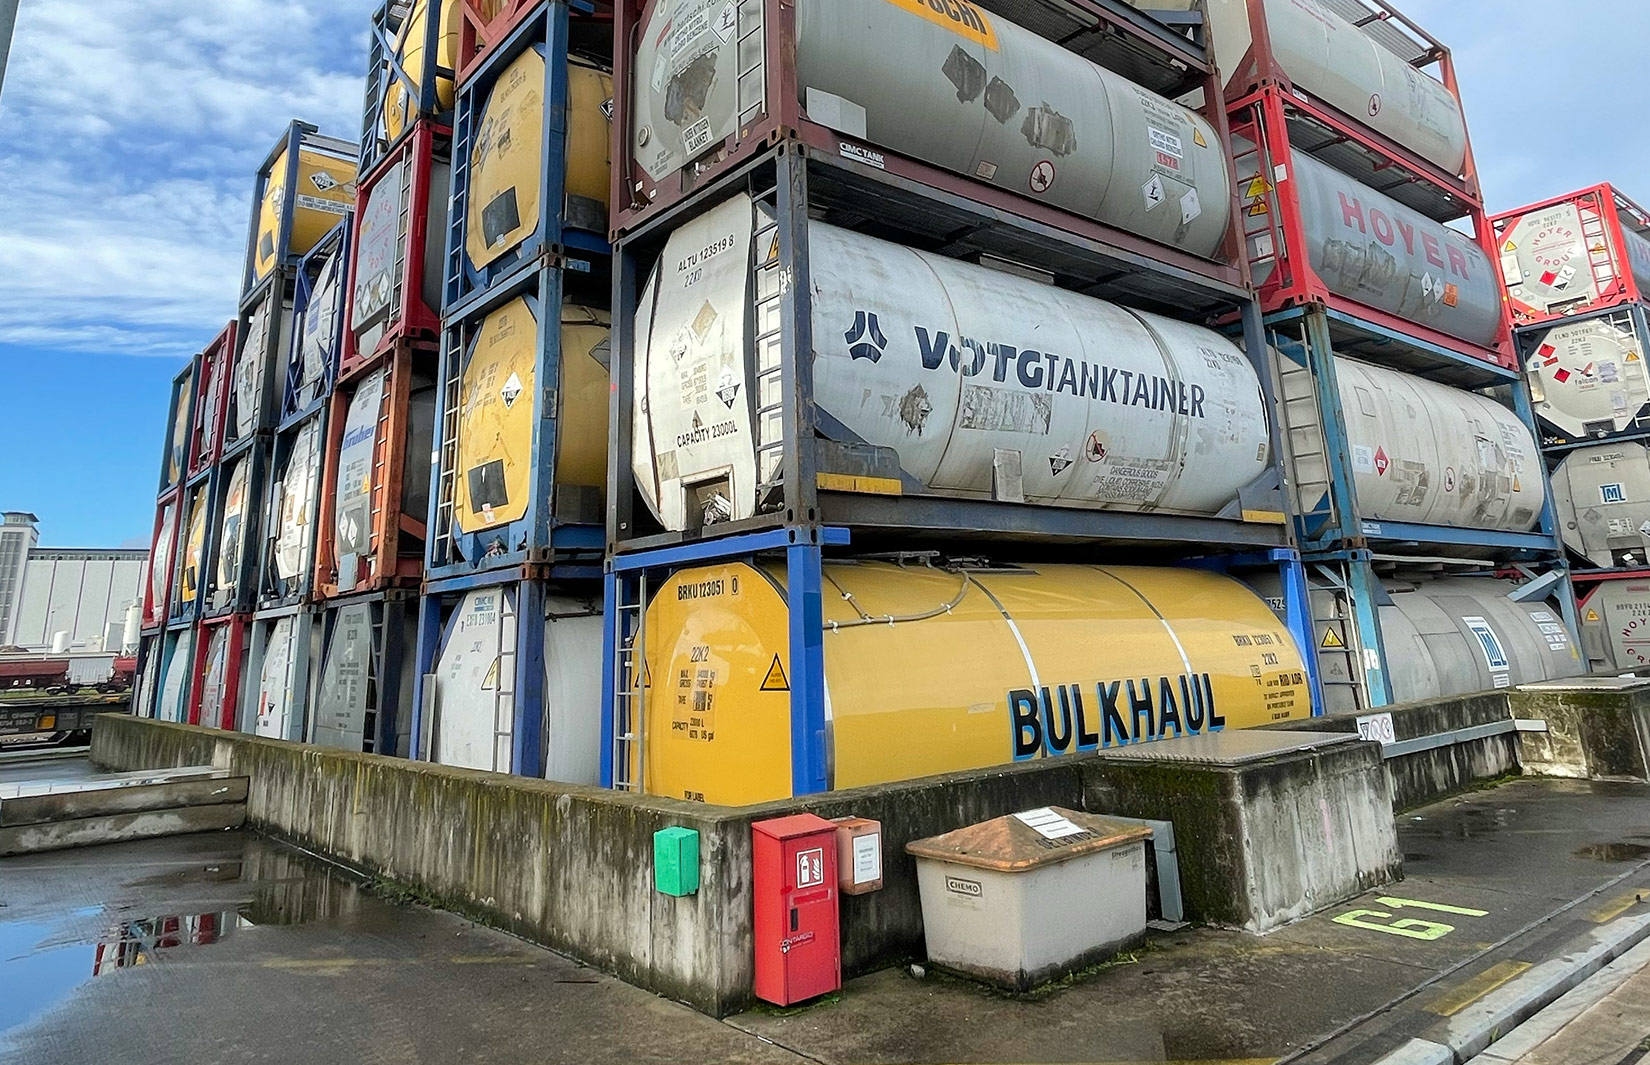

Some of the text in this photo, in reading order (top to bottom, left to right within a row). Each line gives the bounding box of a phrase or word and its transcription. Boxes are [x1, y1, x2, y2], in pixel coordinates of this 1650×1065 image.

[862, 149, 884, 163] TANK
[1338, 192, 1469, 280] HOYER
[1532, 227, 1572, 246] HOYER
[677, 234, 735, 273] ALTU 123519 8
[1574, 377, 1599, 386] falcon
[677, 426, 710, 448] CAPACITY
[1600, 483, 1626, 502] TML
[699, 580, 725, 598] 123051
[691, 646, 709, 663] 22K2
[1262, 653, 1278, 666] 22K2
[700, 730, 708, 740] US
[949, 880, 979, 893] CHEMO
